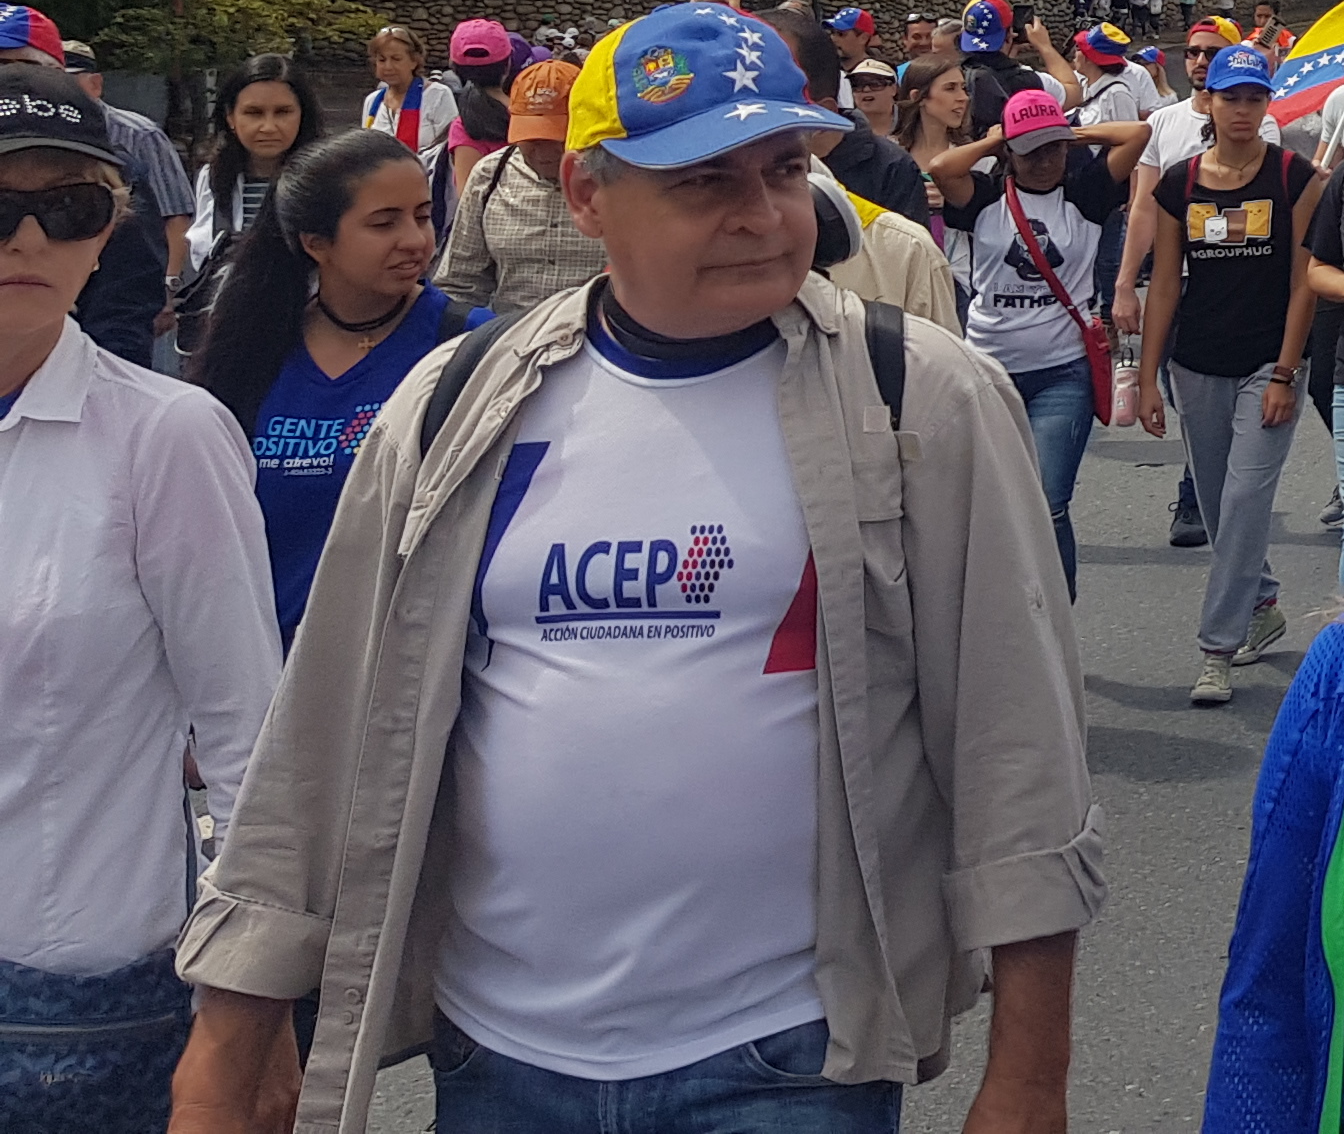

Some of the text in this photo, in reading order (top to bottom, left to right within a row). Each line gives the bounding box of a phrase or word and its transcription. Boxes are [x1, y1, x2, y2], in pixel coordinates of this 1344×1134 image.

[1012, 104, 1059, 124] LAURA
[993, 294, 1058, 308] FATHE
[267, 417, 345, 438] GENTE
[253, 437, 338, 456] OSITIVO
[259, 454, 335, 468] me atrevo!
[539, 539, 678, 613] ACEP
[541, 624, 715, 641] ACCIÓN CIUDADANA EN POSITIVO
